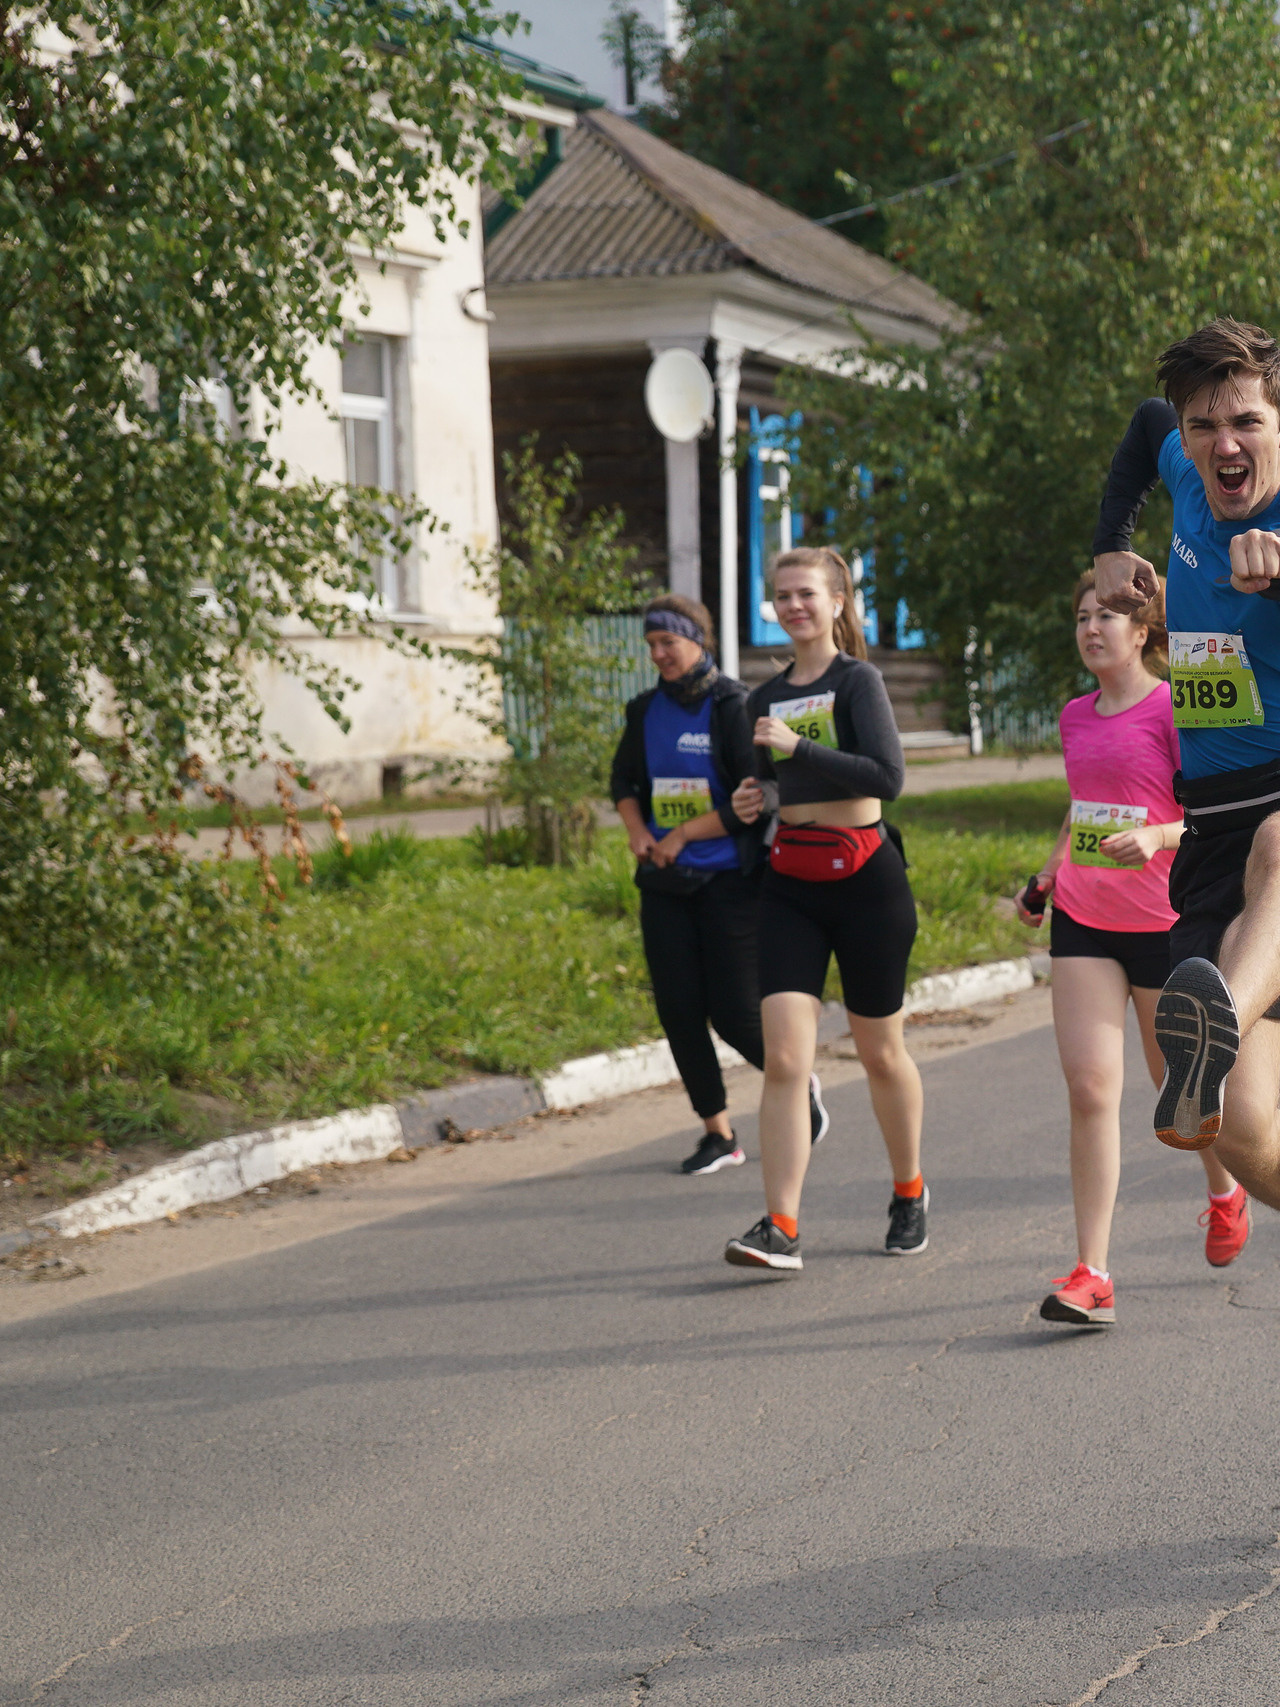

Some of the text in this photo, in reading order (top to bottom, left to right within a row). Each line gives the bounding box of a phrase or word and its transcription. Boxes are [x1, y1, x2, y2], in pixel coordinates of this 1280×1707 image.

[1172, 532, 1198, 568] MARS
[1174, 679, 1237, 709] 3189
[790, 722, 820, 739] 66
[661, 802, 698, 817] 3116
[1075, 832, 1110, 853] 32
